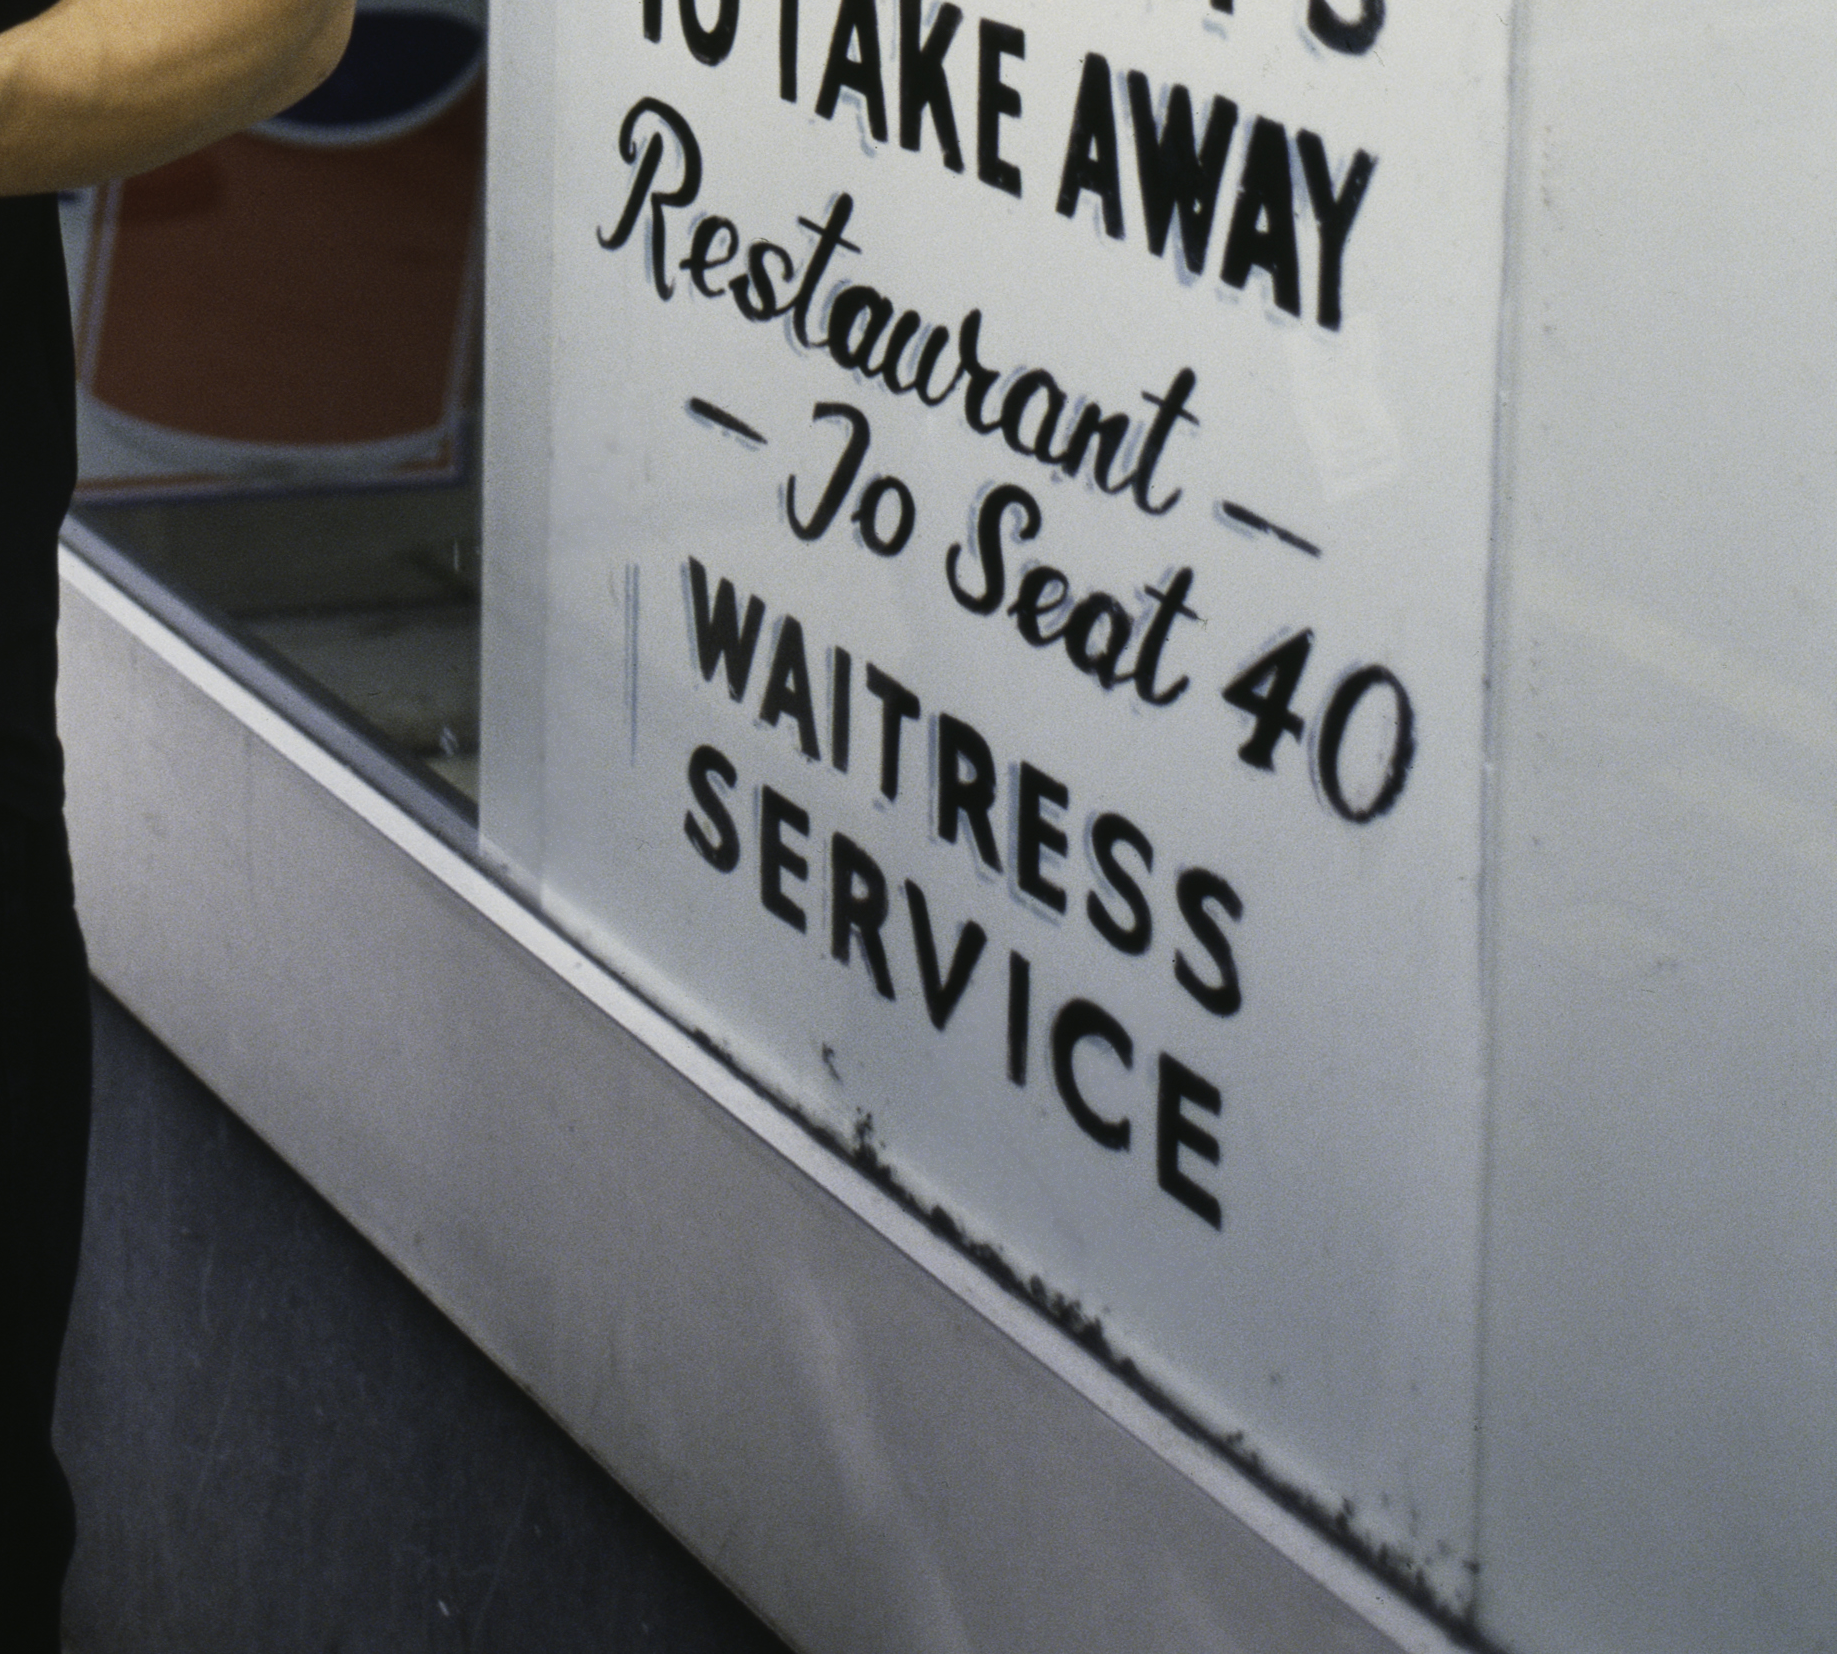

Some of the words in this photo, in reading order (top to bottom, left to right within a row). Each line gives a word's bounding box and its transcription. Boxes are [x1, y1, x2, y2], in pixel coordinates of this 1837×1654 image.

[596, 96, 1200, 514] Restaurant
[1055, 51, 1378, 331] AWAY
[688, 556, 1245, 1019] WAITRESS
[944, 483, 1200, 707] Seat
[1222, 628, 1417, 824] 40
[682, 743, 1224, 1233] SERVICE
